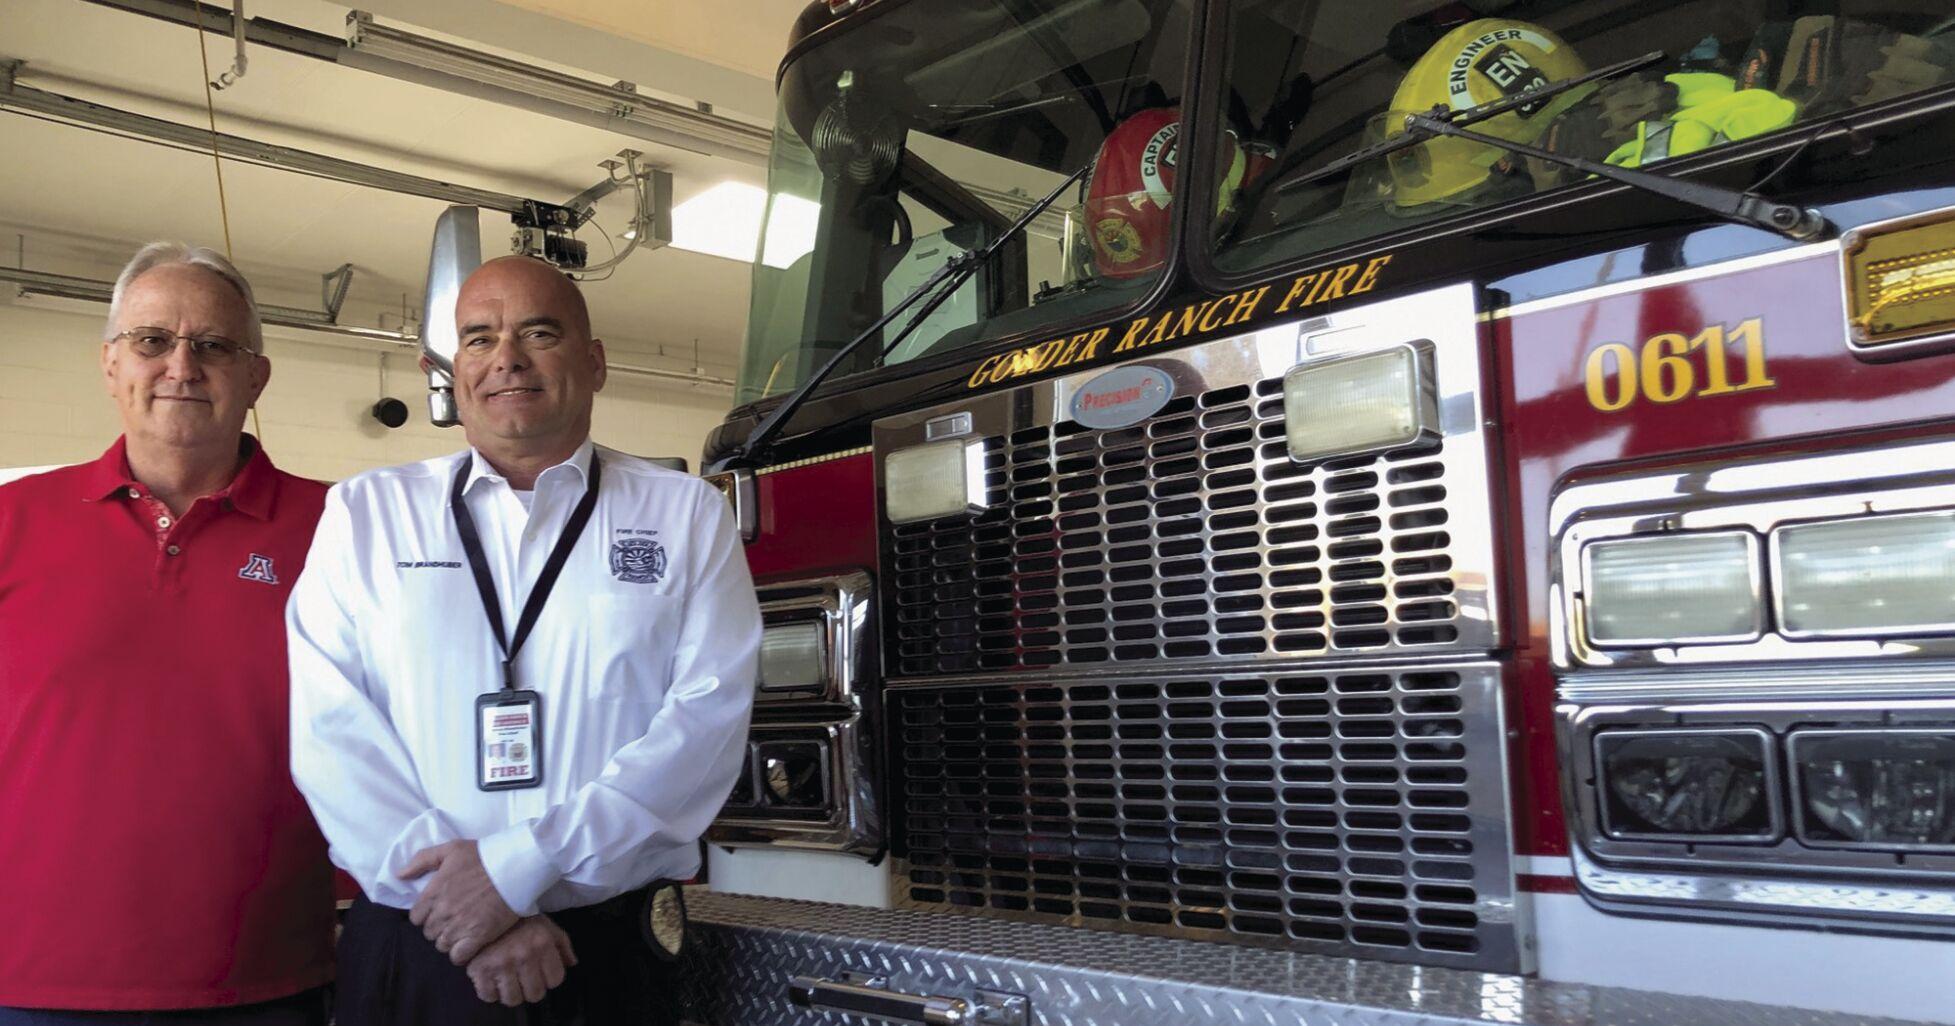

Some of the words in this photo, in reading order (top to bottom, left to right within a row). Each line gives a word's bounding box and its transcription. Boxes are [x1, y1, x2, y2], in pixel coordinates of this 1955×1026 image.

[1451, 29, 1522, 96] ENGINEER
[1486, 51, 1530, 87] EN
[1144, 124, 1180, 177] CAPTAI
[1112, 286, 1271, 354] RANCH
[1274, 254, 1394, 314] FIRE
[1585, 314, 1777, 412] 0611
[238, 553, 280, 585] A
[490, 765, 529, 778] FIRE
